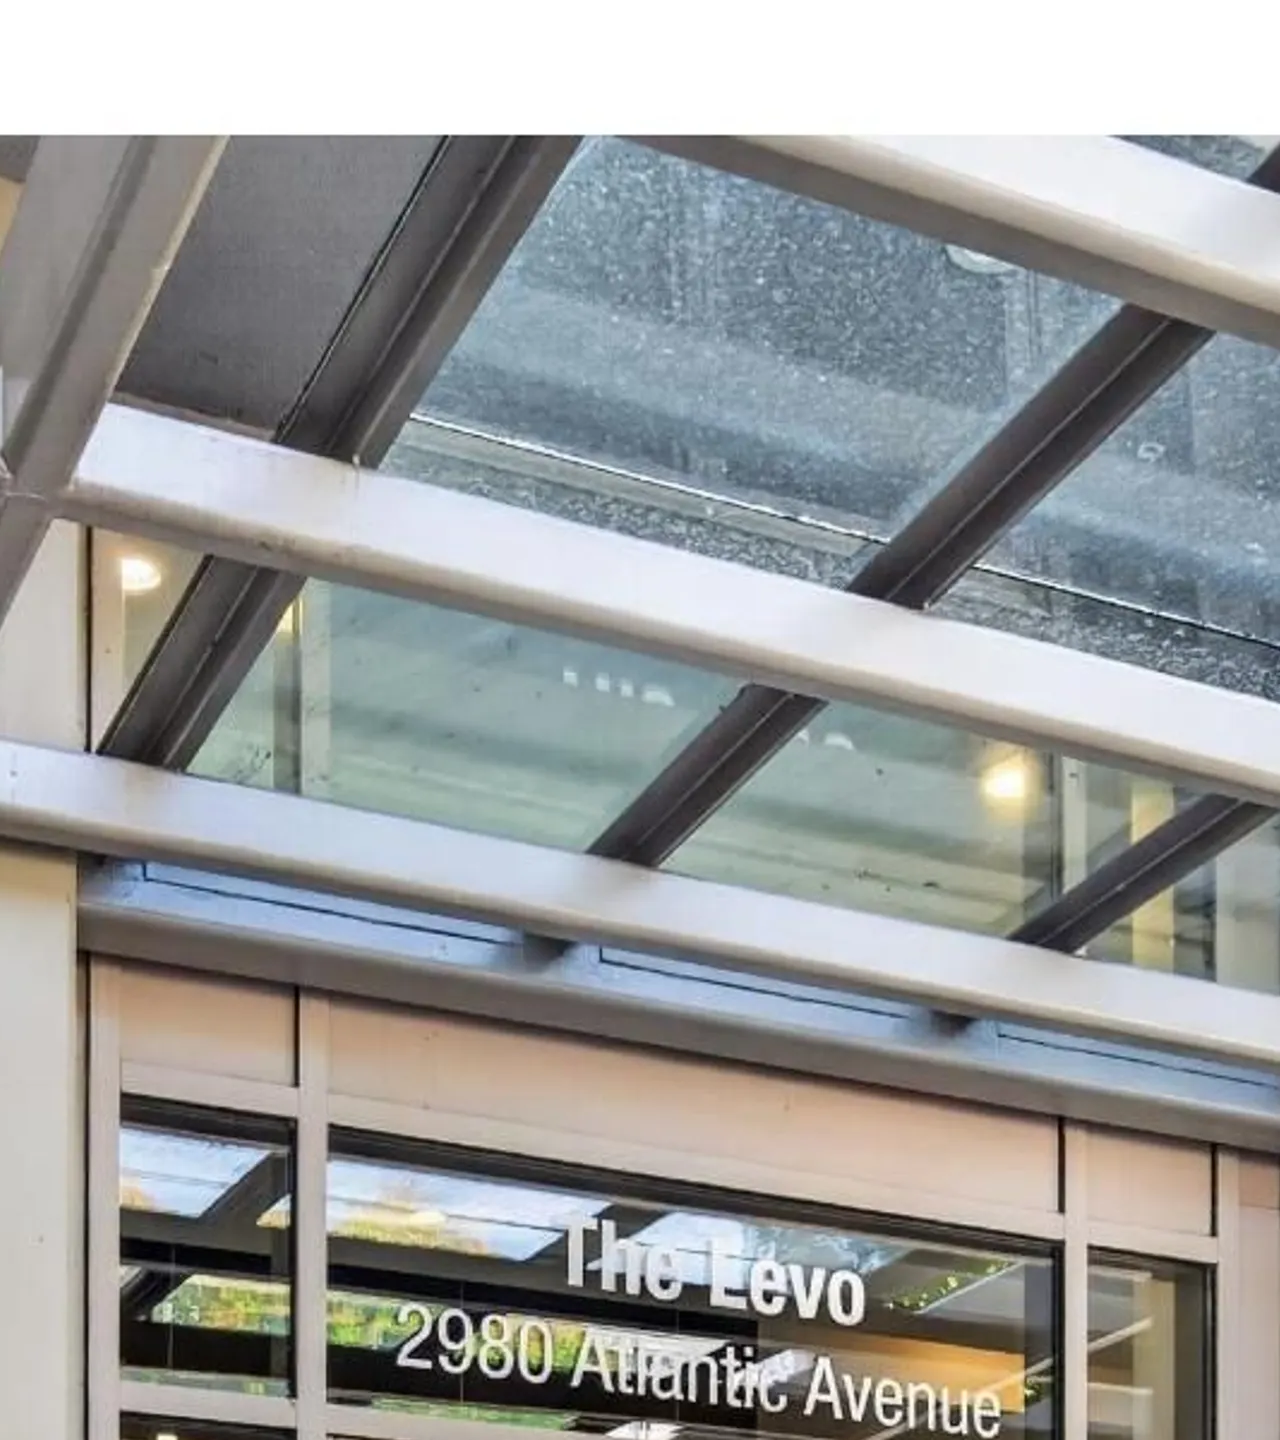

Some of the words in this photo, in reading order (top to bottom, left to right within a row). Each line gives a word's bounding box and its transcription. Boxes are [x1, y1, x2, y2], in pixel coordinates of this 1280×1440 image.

[562, 1212, 683, 1302] The
[710, 1238, 866, 1327] Levo
[396, 1302, 555, 1385] 2980
[570, 1325, 790, 1414] Atlantic
[803, 1356, 1003, 1440] Avenue
